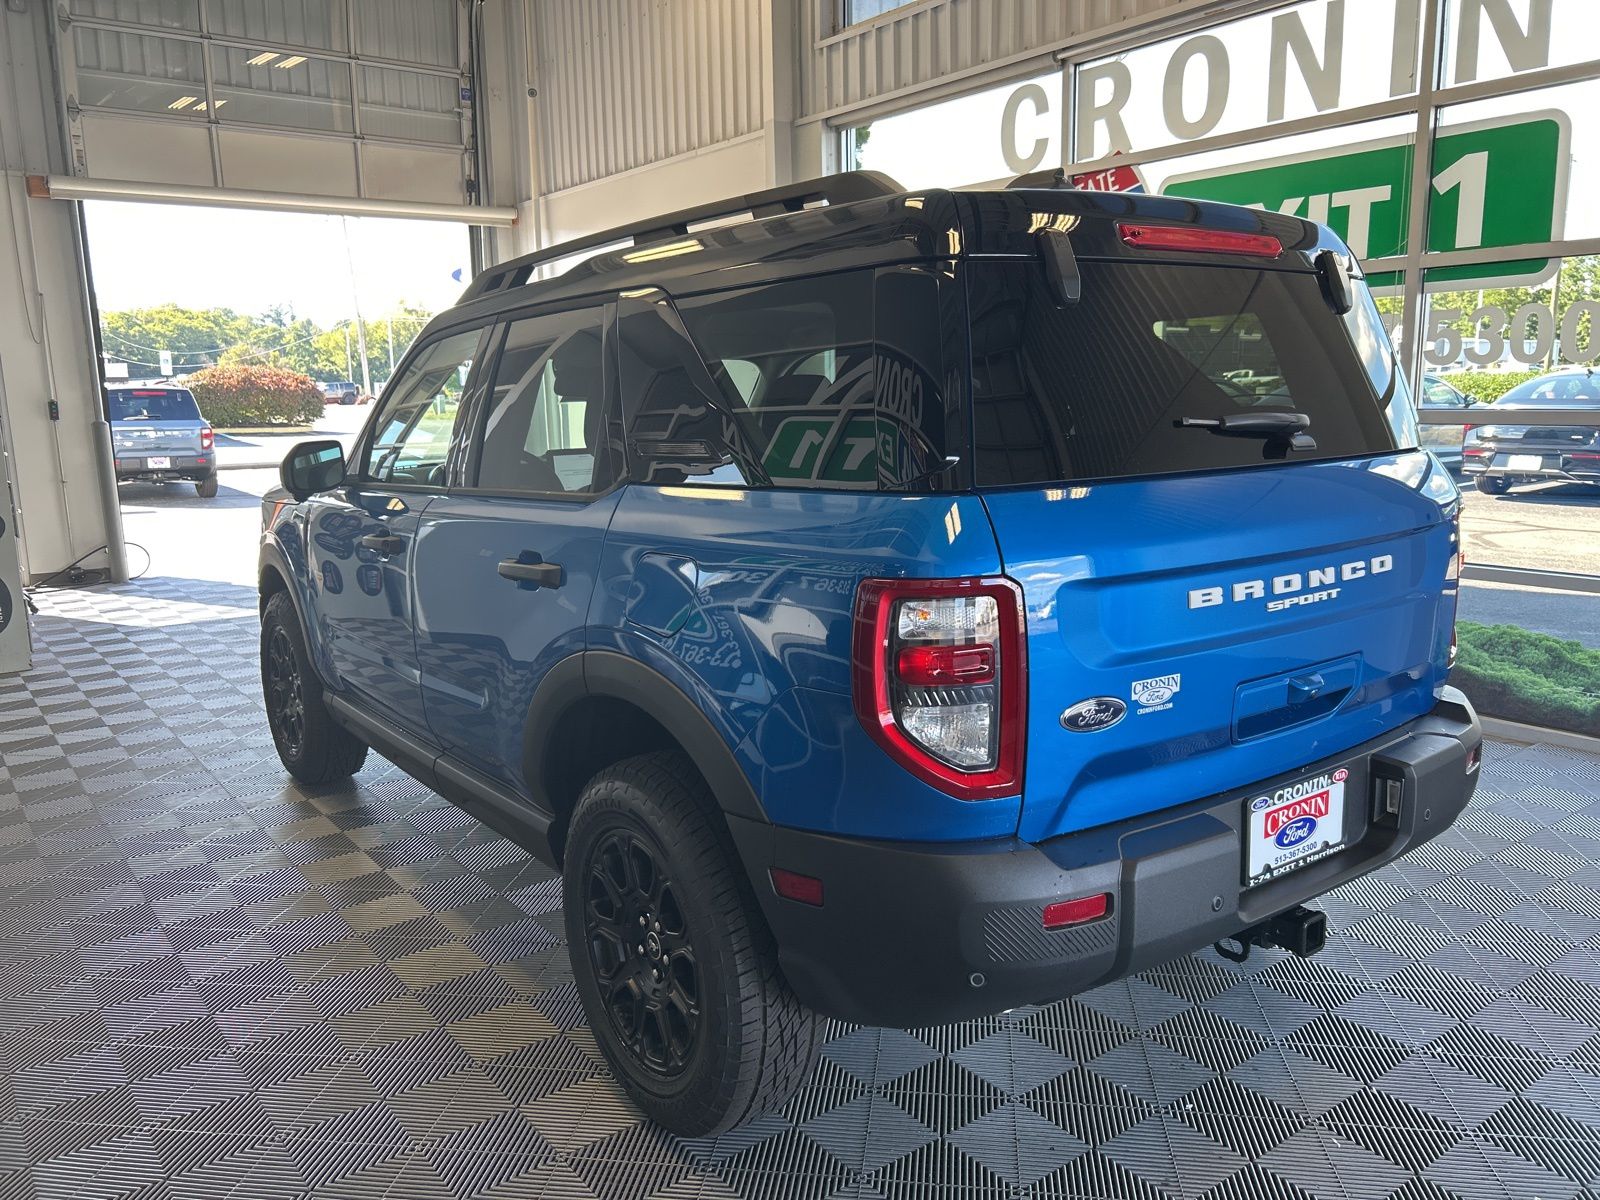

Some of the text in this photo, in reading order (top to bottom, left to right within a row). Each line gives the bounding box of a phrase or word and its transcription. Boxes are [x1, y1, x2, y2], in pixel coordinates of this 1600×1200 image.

[1432, 152, 1489, 249] 1
[1423, 299, 1600, 366] 5300
[1188, 554, 1393, 609] BRONCO
[1266, 588, 1342, 612] SPORT
[1133, 675, 1179, 696] CRONIN
[1145, 690, 1166, 703] Ford
[1078, 705, 1114, 726] Ford
[1274, 774, 1329, 805] CRONIN
[1267, 794, 1327, 835] CRONIN
[1283, 821, 1310, 844] Ford
[1249, 843, 1345, 887] I-74 EXIT 1 Harrison
[1274, 841, 1318, 865] 513-367-5300
